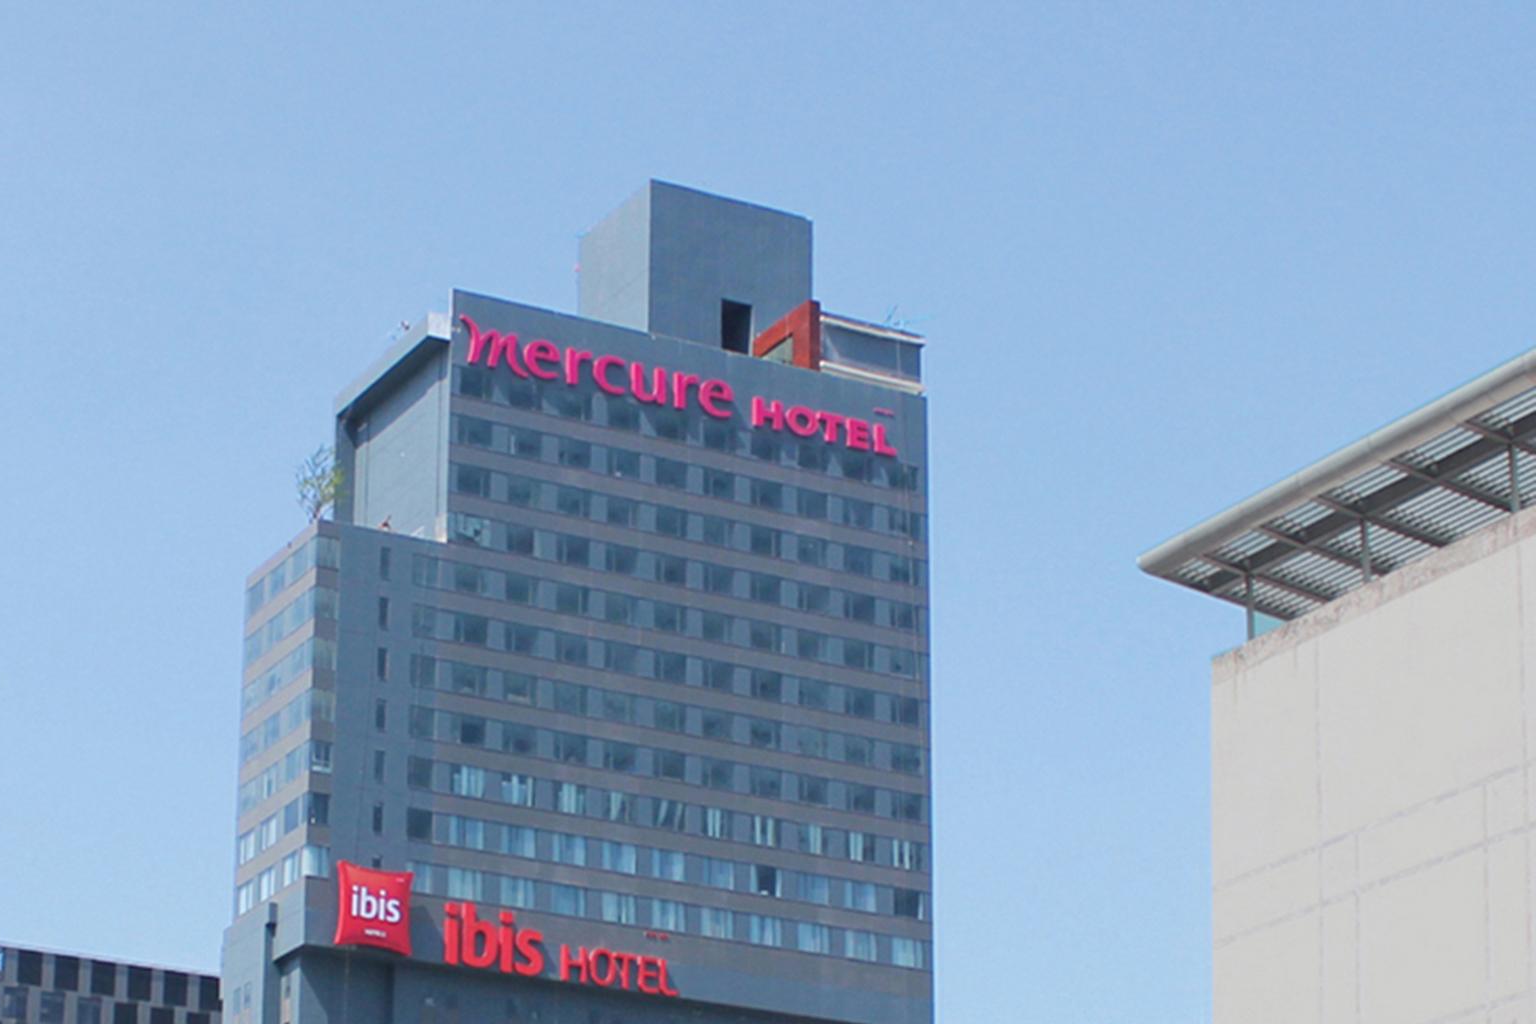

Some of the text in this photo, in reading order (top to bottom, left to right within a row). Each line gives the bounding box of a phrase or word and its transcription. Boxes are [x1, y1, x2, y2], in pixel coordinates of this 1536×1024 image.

[458, 313, 899, 458] mercure HOTEL
[351, 885, 401, 923] ibis
[443, 901, 679, 997] ibis HOTEL
